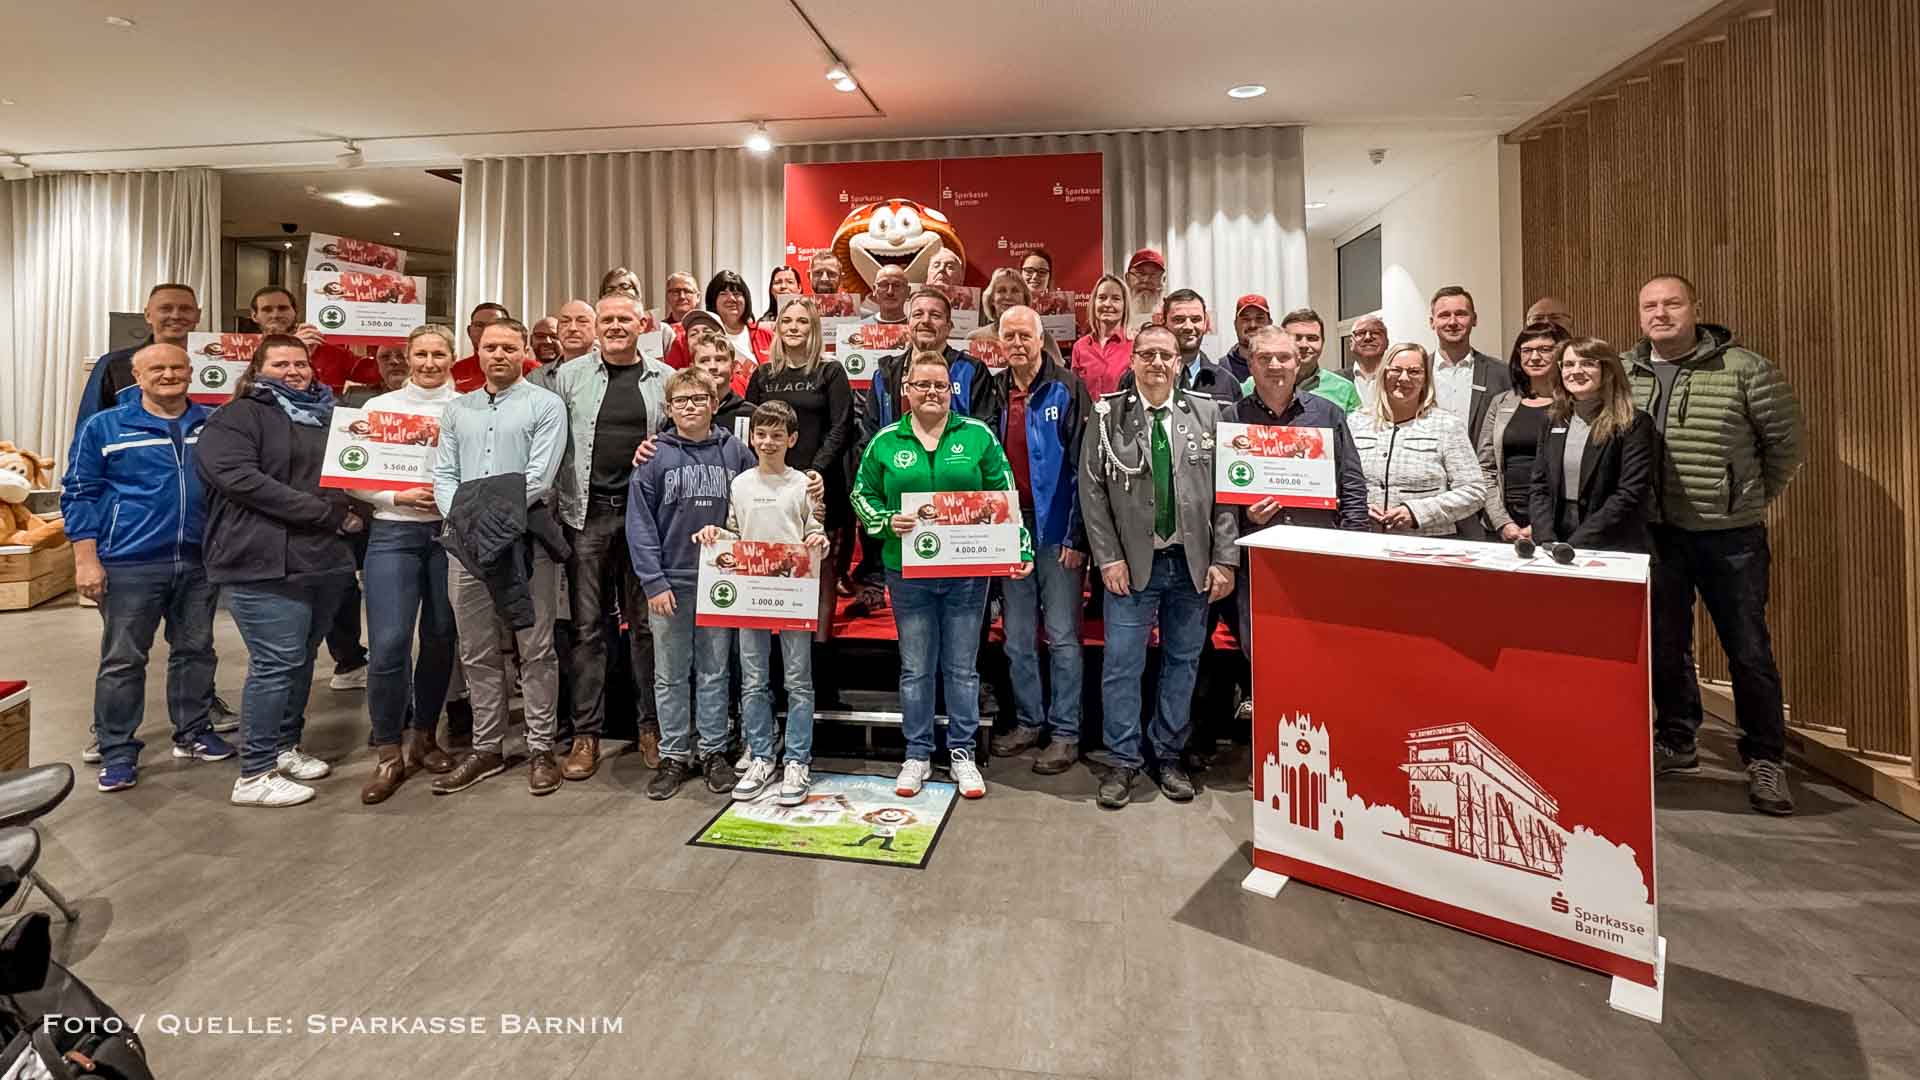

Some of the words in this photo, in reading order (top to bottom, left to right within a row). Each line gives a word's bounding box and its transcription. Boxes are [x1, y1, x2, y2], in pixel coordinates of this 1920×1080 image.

[954, 191, 988, 200] Sparkasse
[1065, 187, 1100, 197] Sparkasse
[955, 199, 980, 207] Barnim
[1065, 195, 1091, 203] Barnim
[1010, 241, 1045, 250] Sparkasse
[351, 273, 372, 286] Wir
[868, 323, 885, 336] Wir
[380, 413, 403, 427] Wir
[1044, 405, 1058, 422] FB
[1256, 426, 1279, 439] Wir
[943, 493, 965, 507] Wir
[948, 505, 984, 525] helfen
[742, 541, 766, 557] Wir
[748, 556, 783, 576] helfen
[1574, 906, 1646, 936] Sparkasse
[1575, 920, 1625, 944] Barnim
